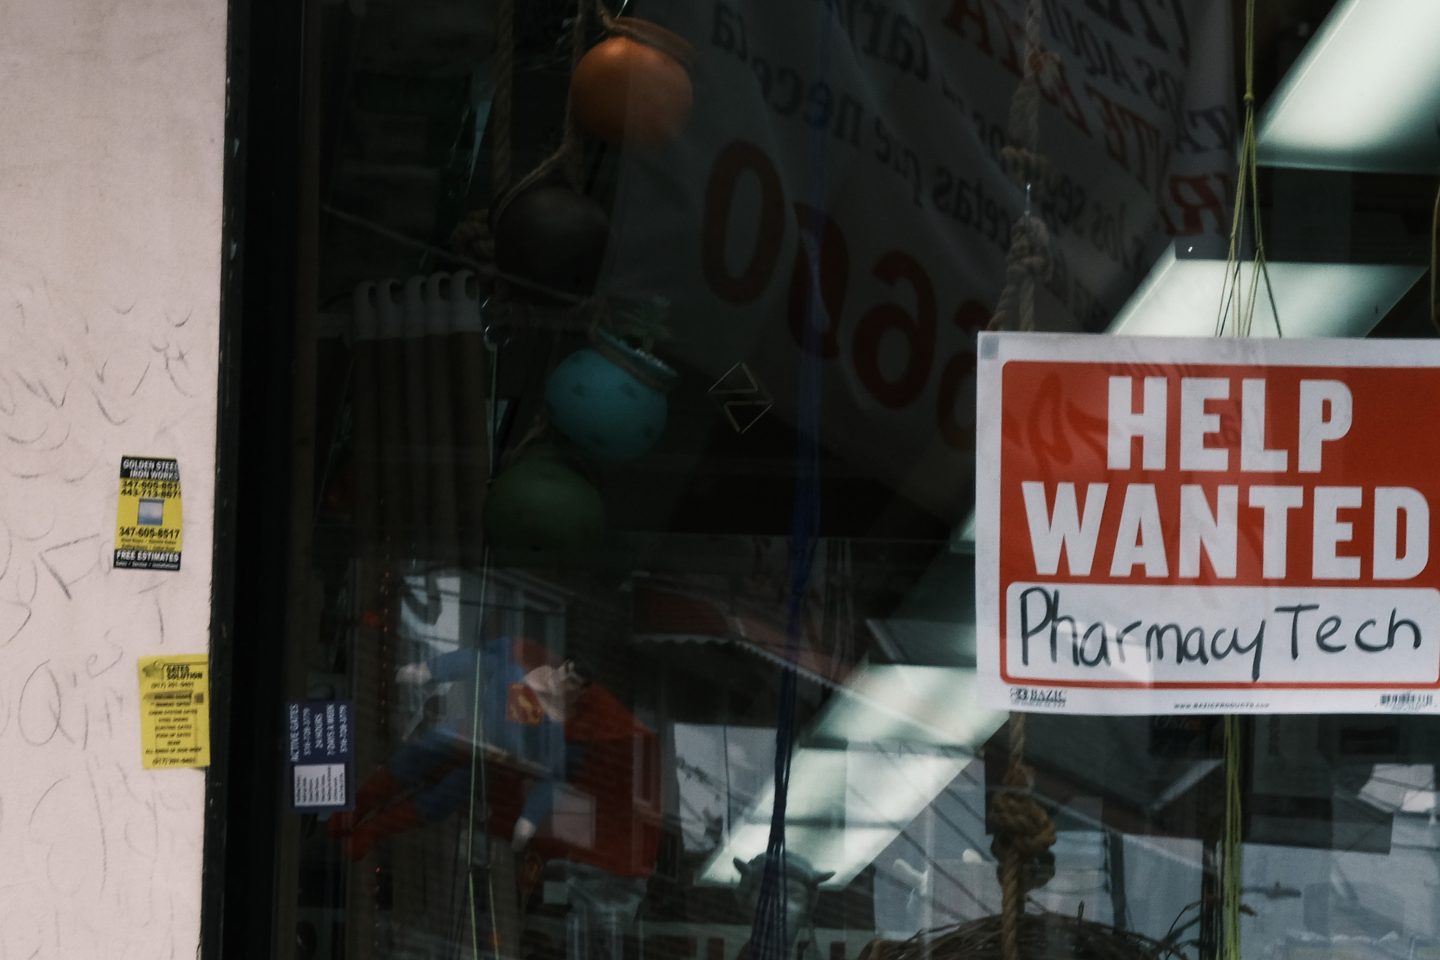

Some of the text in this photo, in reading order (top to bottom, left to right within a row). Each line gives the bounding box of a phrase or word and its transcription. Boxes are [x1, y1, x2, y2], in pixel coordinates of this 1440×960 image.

[1106, 376, 1353, 473] HELP
[1021, 481, 1430, 580] WANTED
[1020, 586, 1422, 682] Pharmacy Tech
